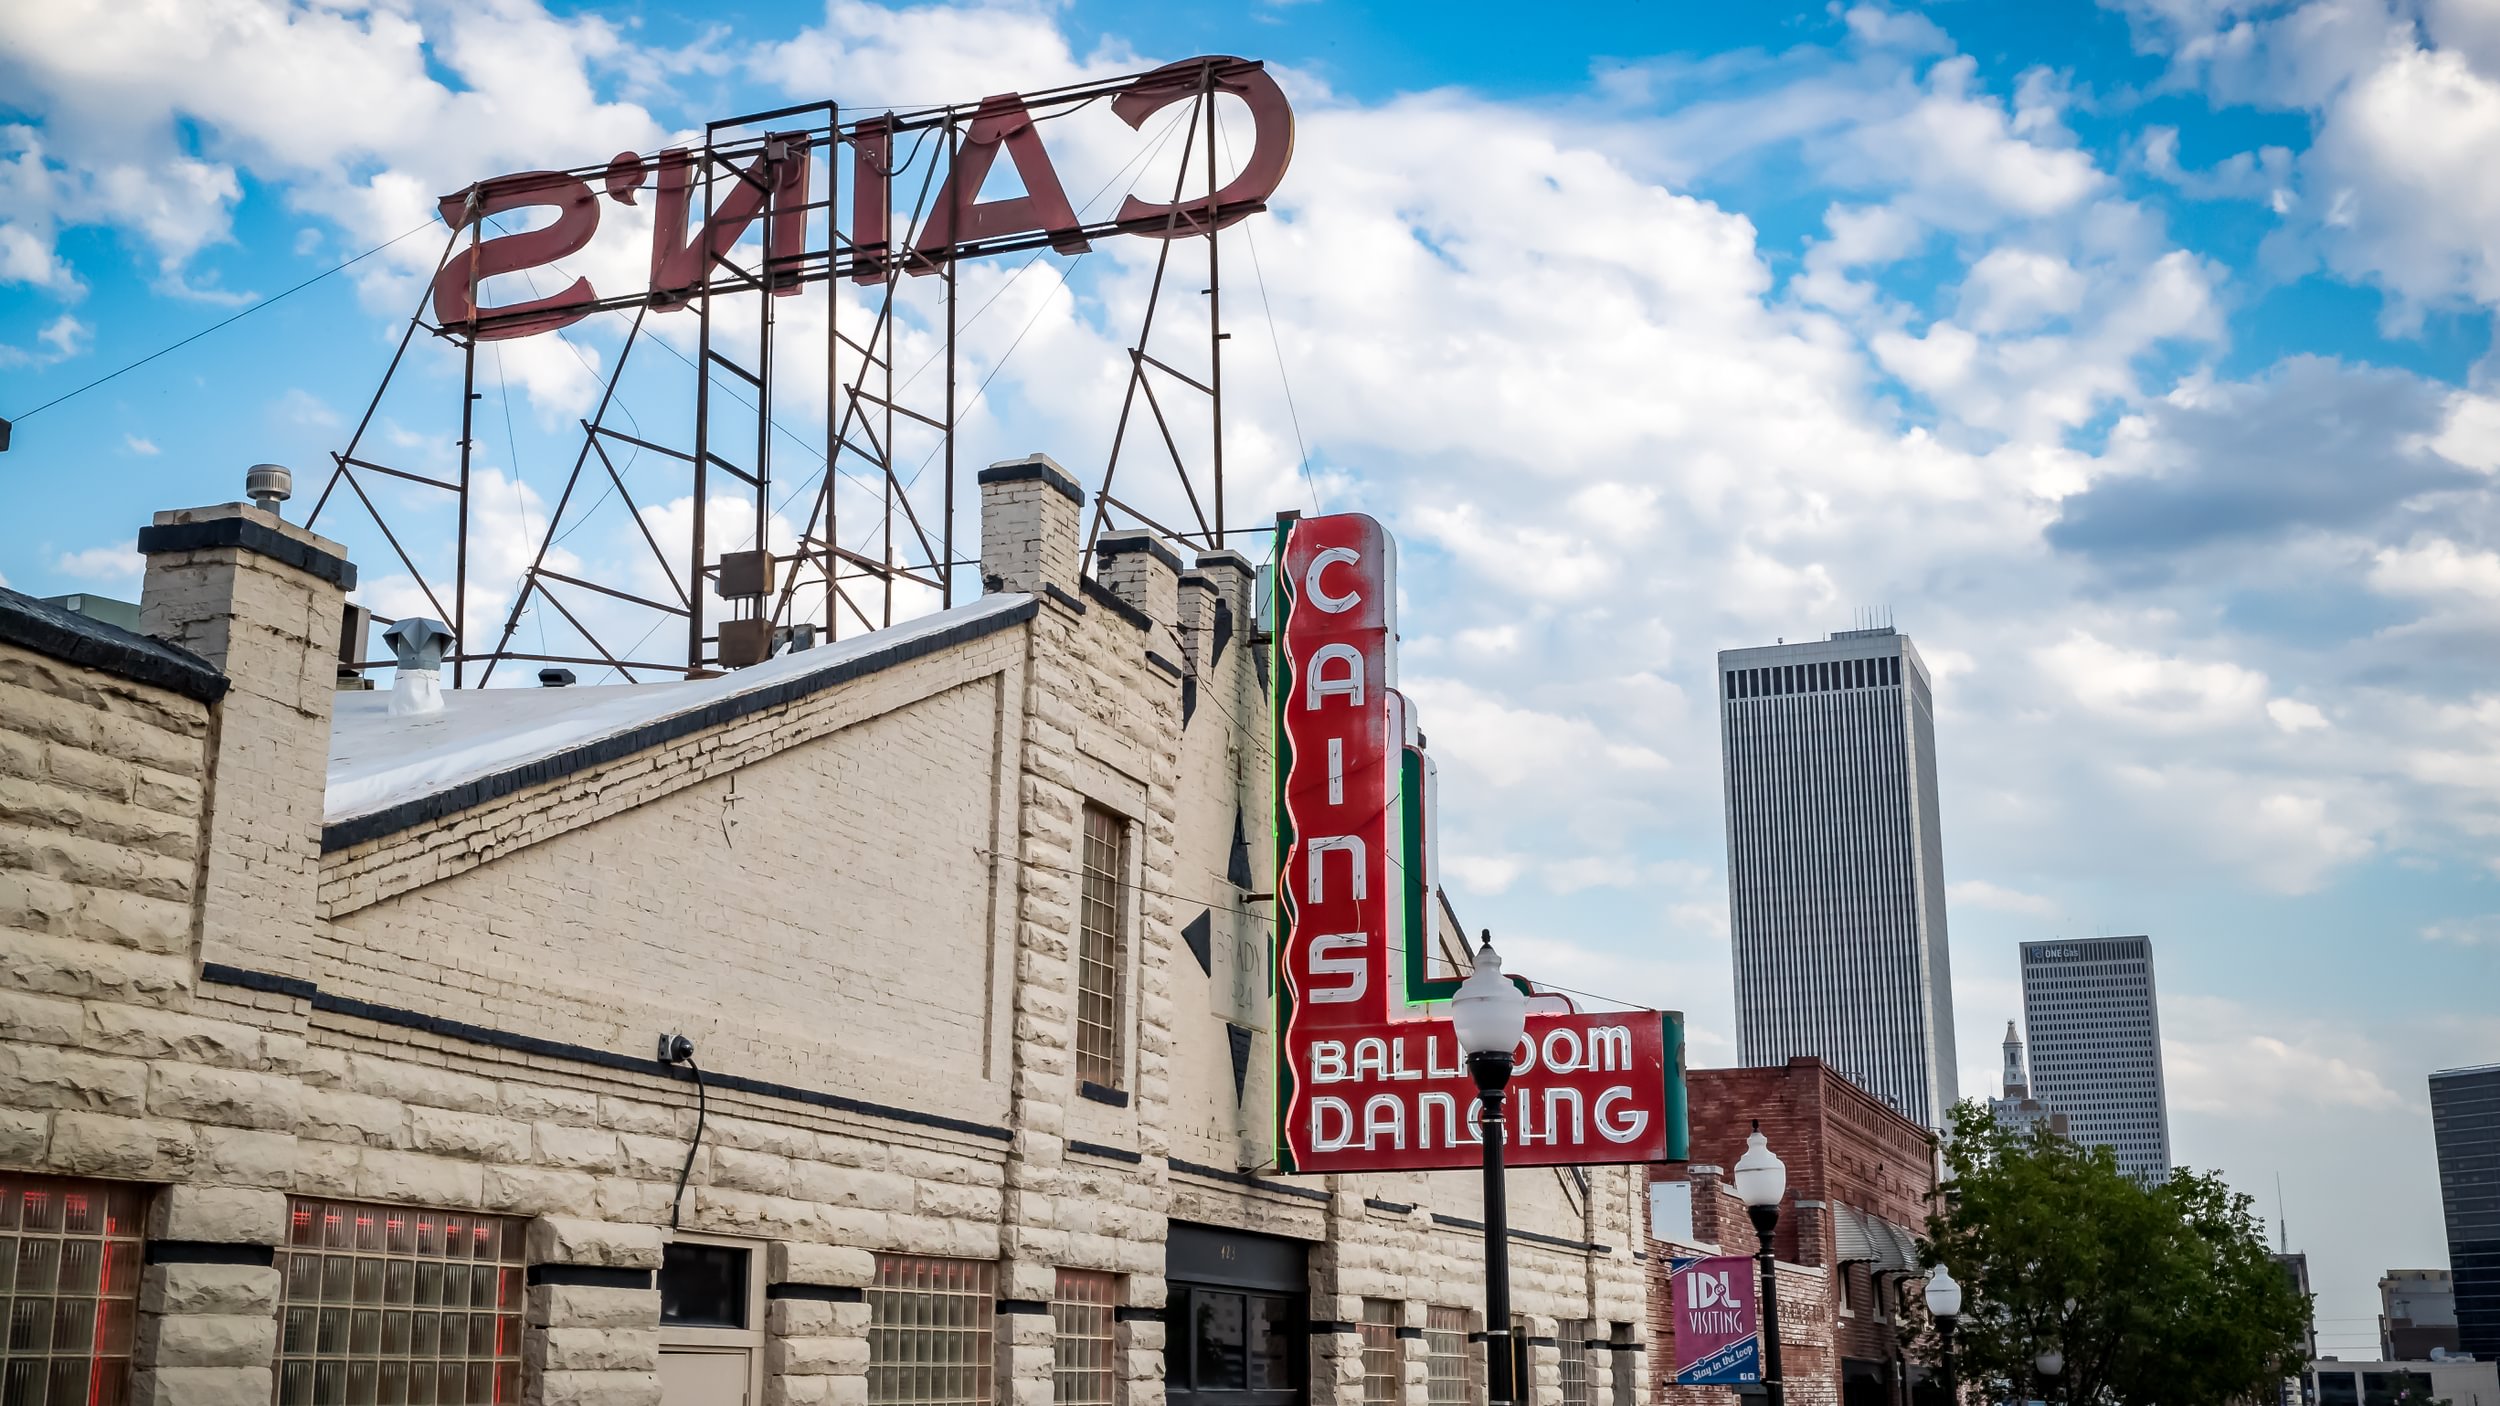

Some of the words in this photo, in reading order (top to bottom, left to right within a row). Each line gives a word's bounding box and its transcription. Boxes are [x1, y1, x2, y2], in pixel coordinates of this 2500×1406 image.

[1305, 546, 1369, 1003] CAINS
[2045, 949, 2062, 958] ONE
[1311, 1025, 1632, 1084] BALLOOM
[1689, 1310, 1743, 1334] VISITING
[1692, 1366, 1712, 1381] Stay
[1712, 1361, 1722, 1370] in
[1721, 1354, 1735, 1366] the
[1735, 1345, 1753, 1359] loop
